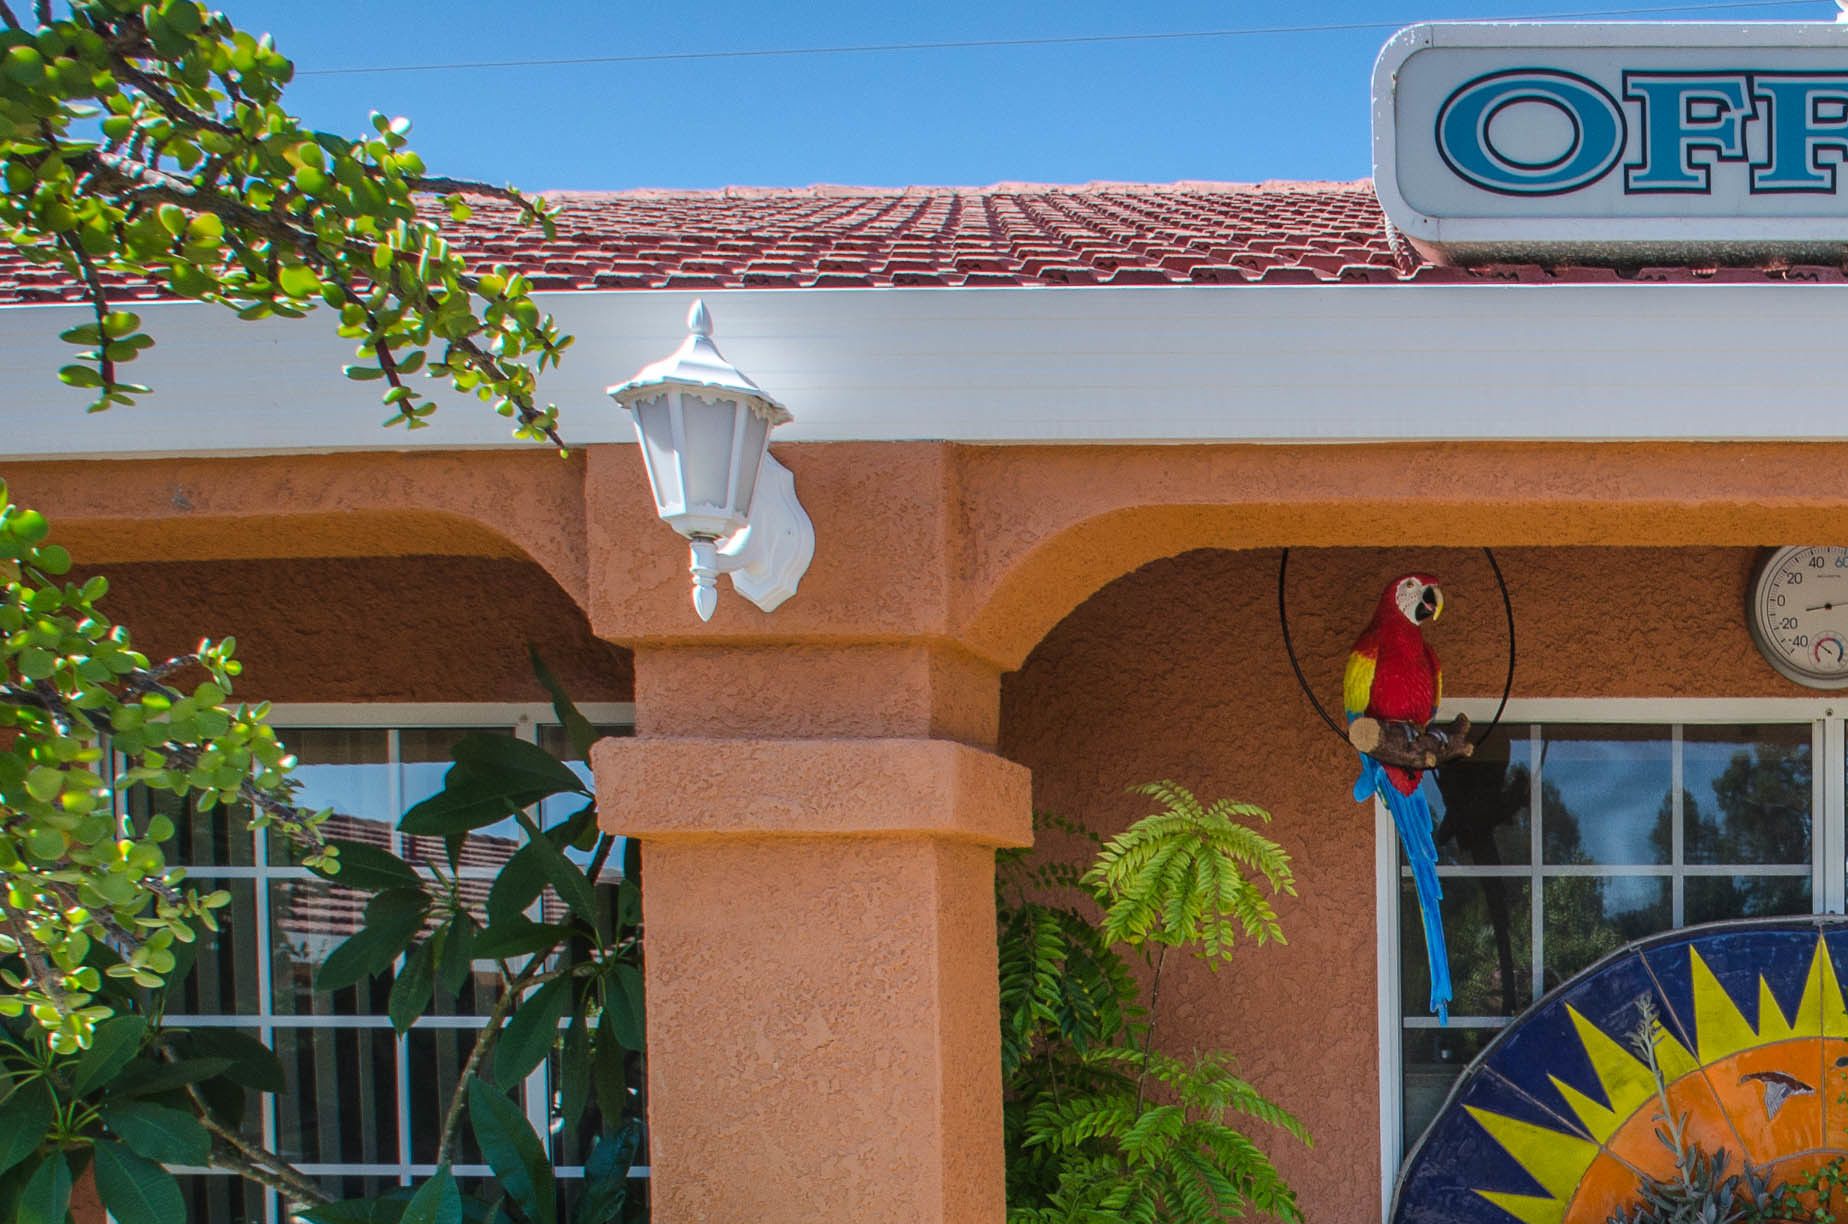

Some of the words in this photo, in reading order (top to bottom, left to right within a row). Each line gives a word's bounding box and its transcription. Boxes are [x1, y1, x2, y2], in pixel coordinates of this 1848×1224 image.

[1808, 556, 1825, 569] 40
[1786, 572, 1803, 585] 20
[1776, 594, 1786, 607] 0
[1779, 617, 1798, 630] -20
[1788, 635, 1808, 647] -40
